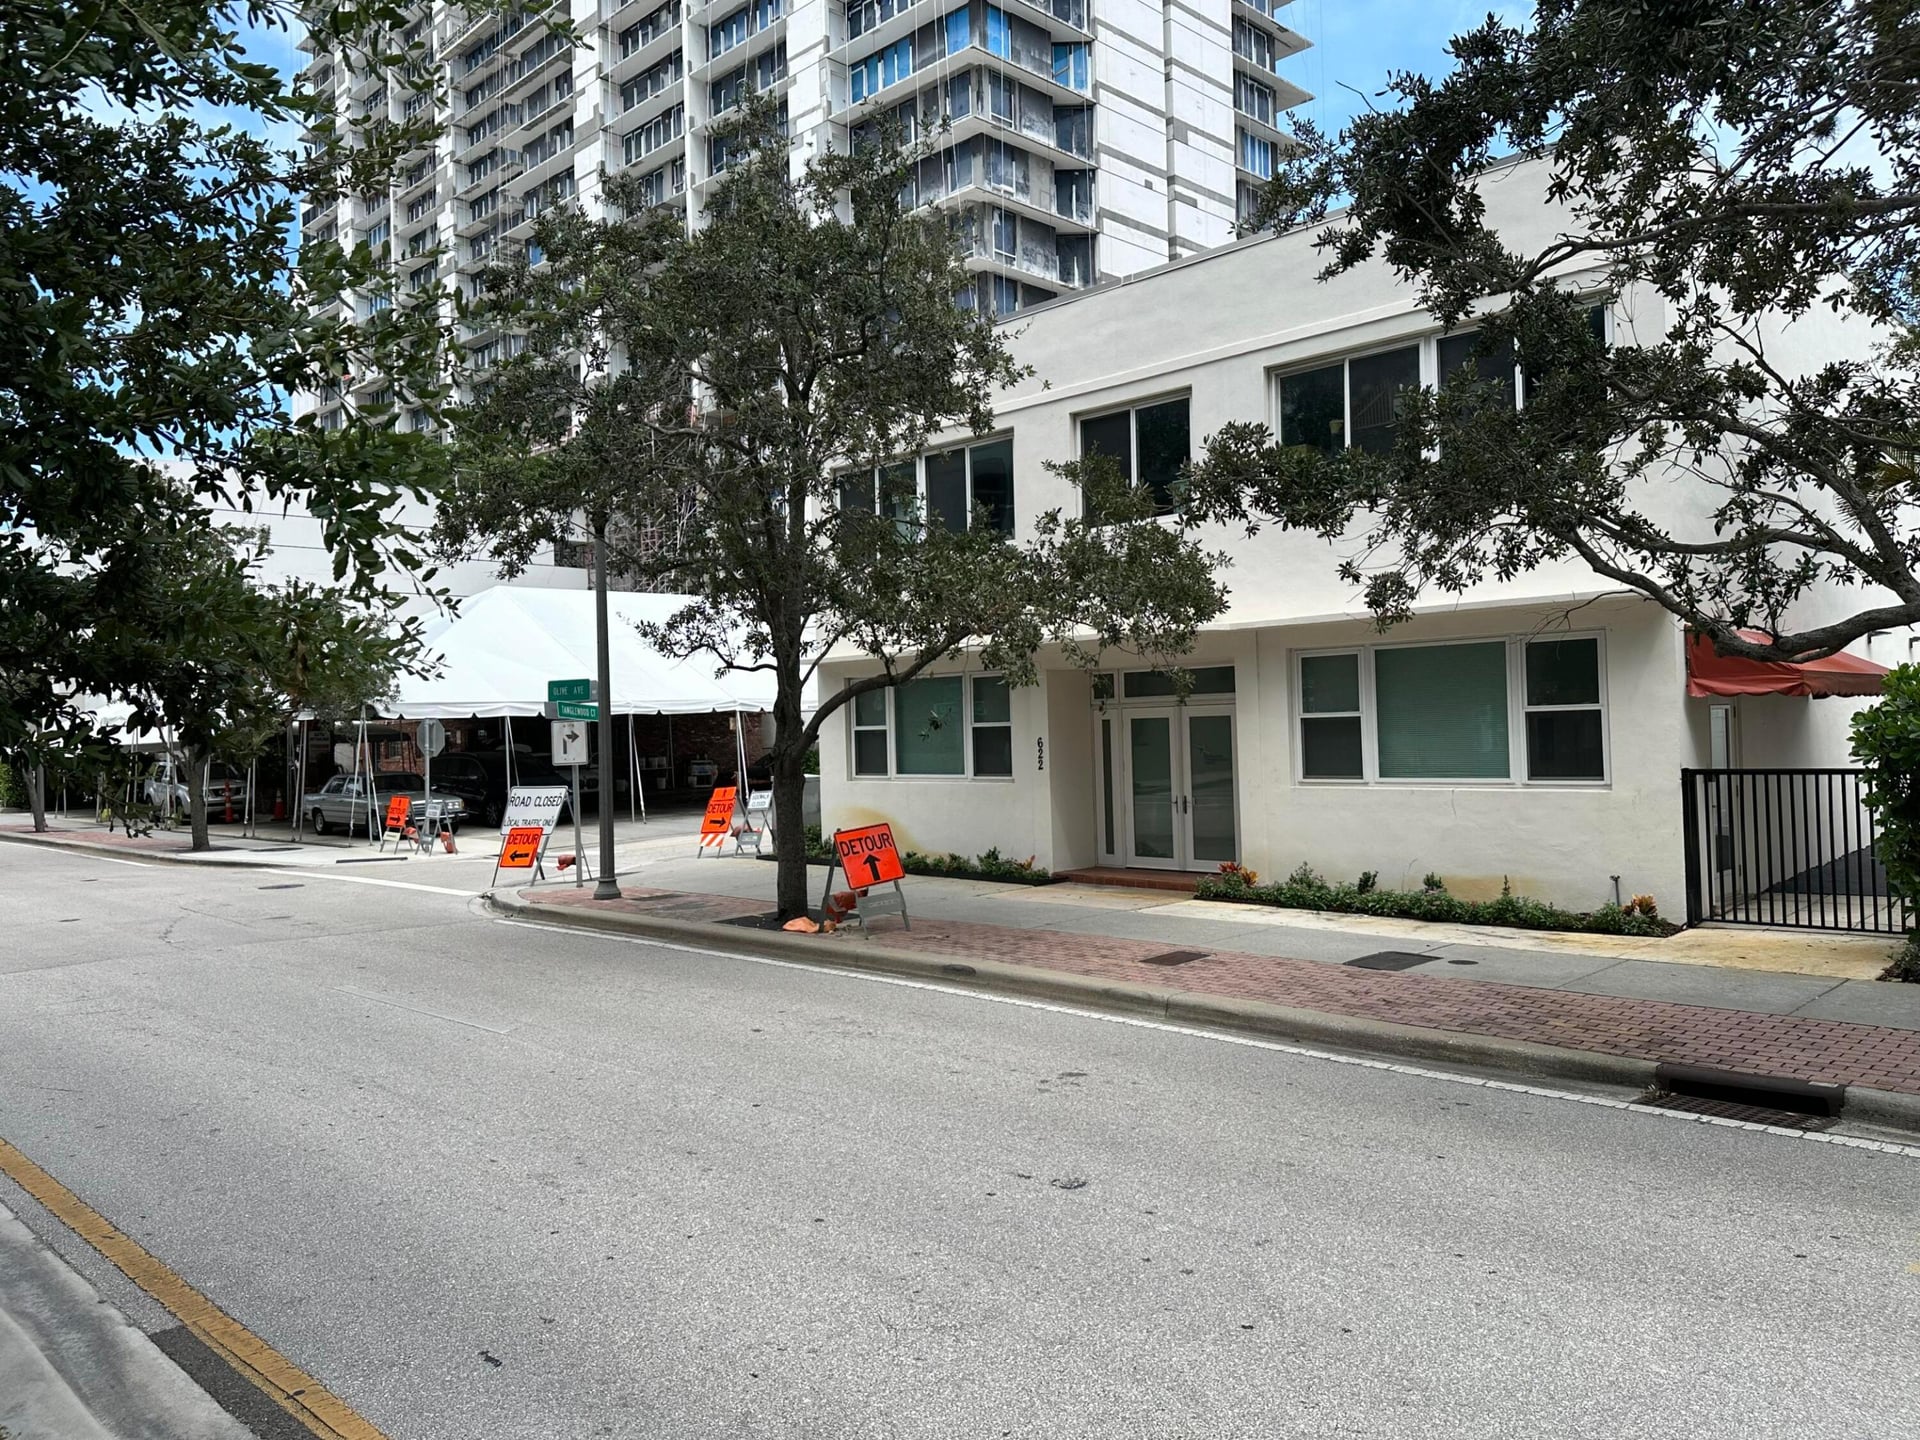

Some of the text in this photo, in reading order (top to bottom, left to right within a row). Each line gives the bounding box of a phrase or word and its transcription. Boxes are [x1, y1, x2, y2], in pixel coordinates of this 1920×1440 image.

[553, 685, 584, 696] OLIVE AVE
[561, 705, 596, 718] TANGLEWOOD CT
[510, 795, 563, 807] ROAD CLOSED
[707, 803, 734, 814] DETOUR
[503, 818, 555, 827] LOCAL TRAFFIC ONLY
[508, 833, 540, 845] DETOUR
[839, 832, 893, 858] DETOUR
